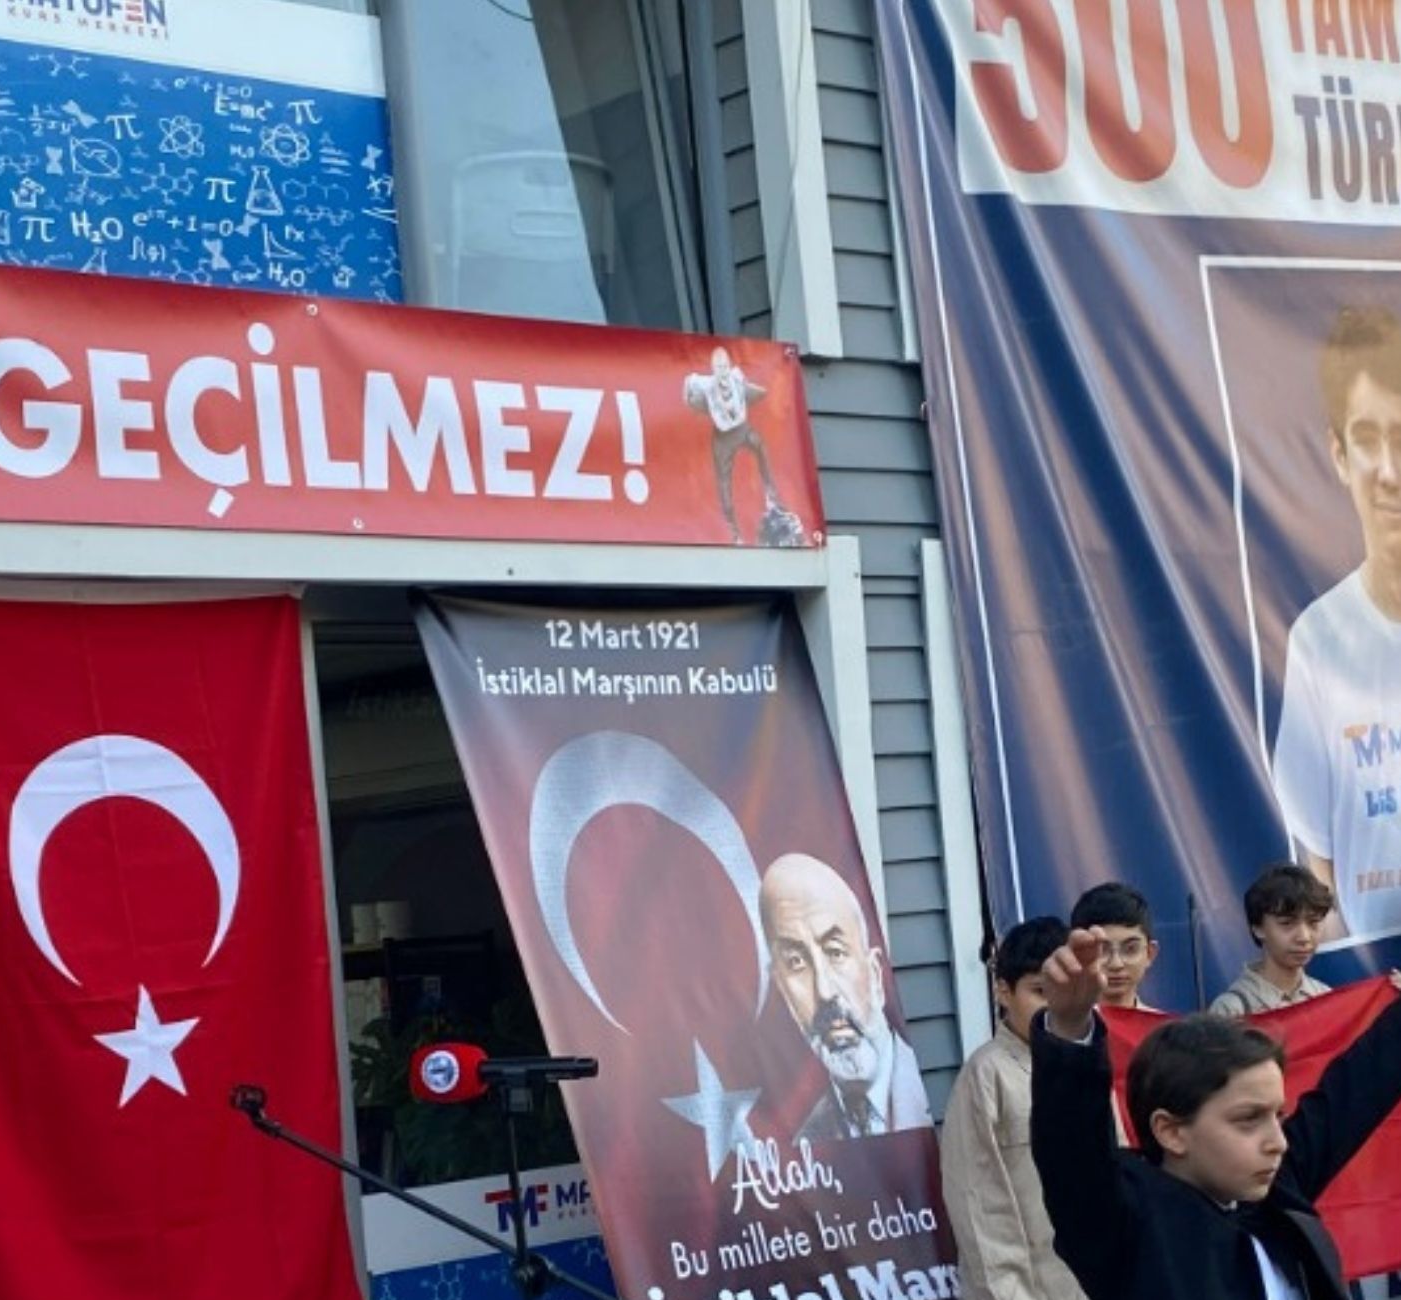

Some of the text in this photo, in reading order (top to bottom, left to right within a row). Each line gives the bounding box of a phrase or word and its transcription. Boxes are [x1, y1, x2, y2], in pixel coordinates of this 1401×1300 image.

[546, 620, 700, 649] 12 Mart 1921
[475, 657, 778, 704] İstiklal Marşının Kabulü
[732, 1138, 843, 1214] Allah,
[671, 1197, 938, 1279] Bu millete bir daha
